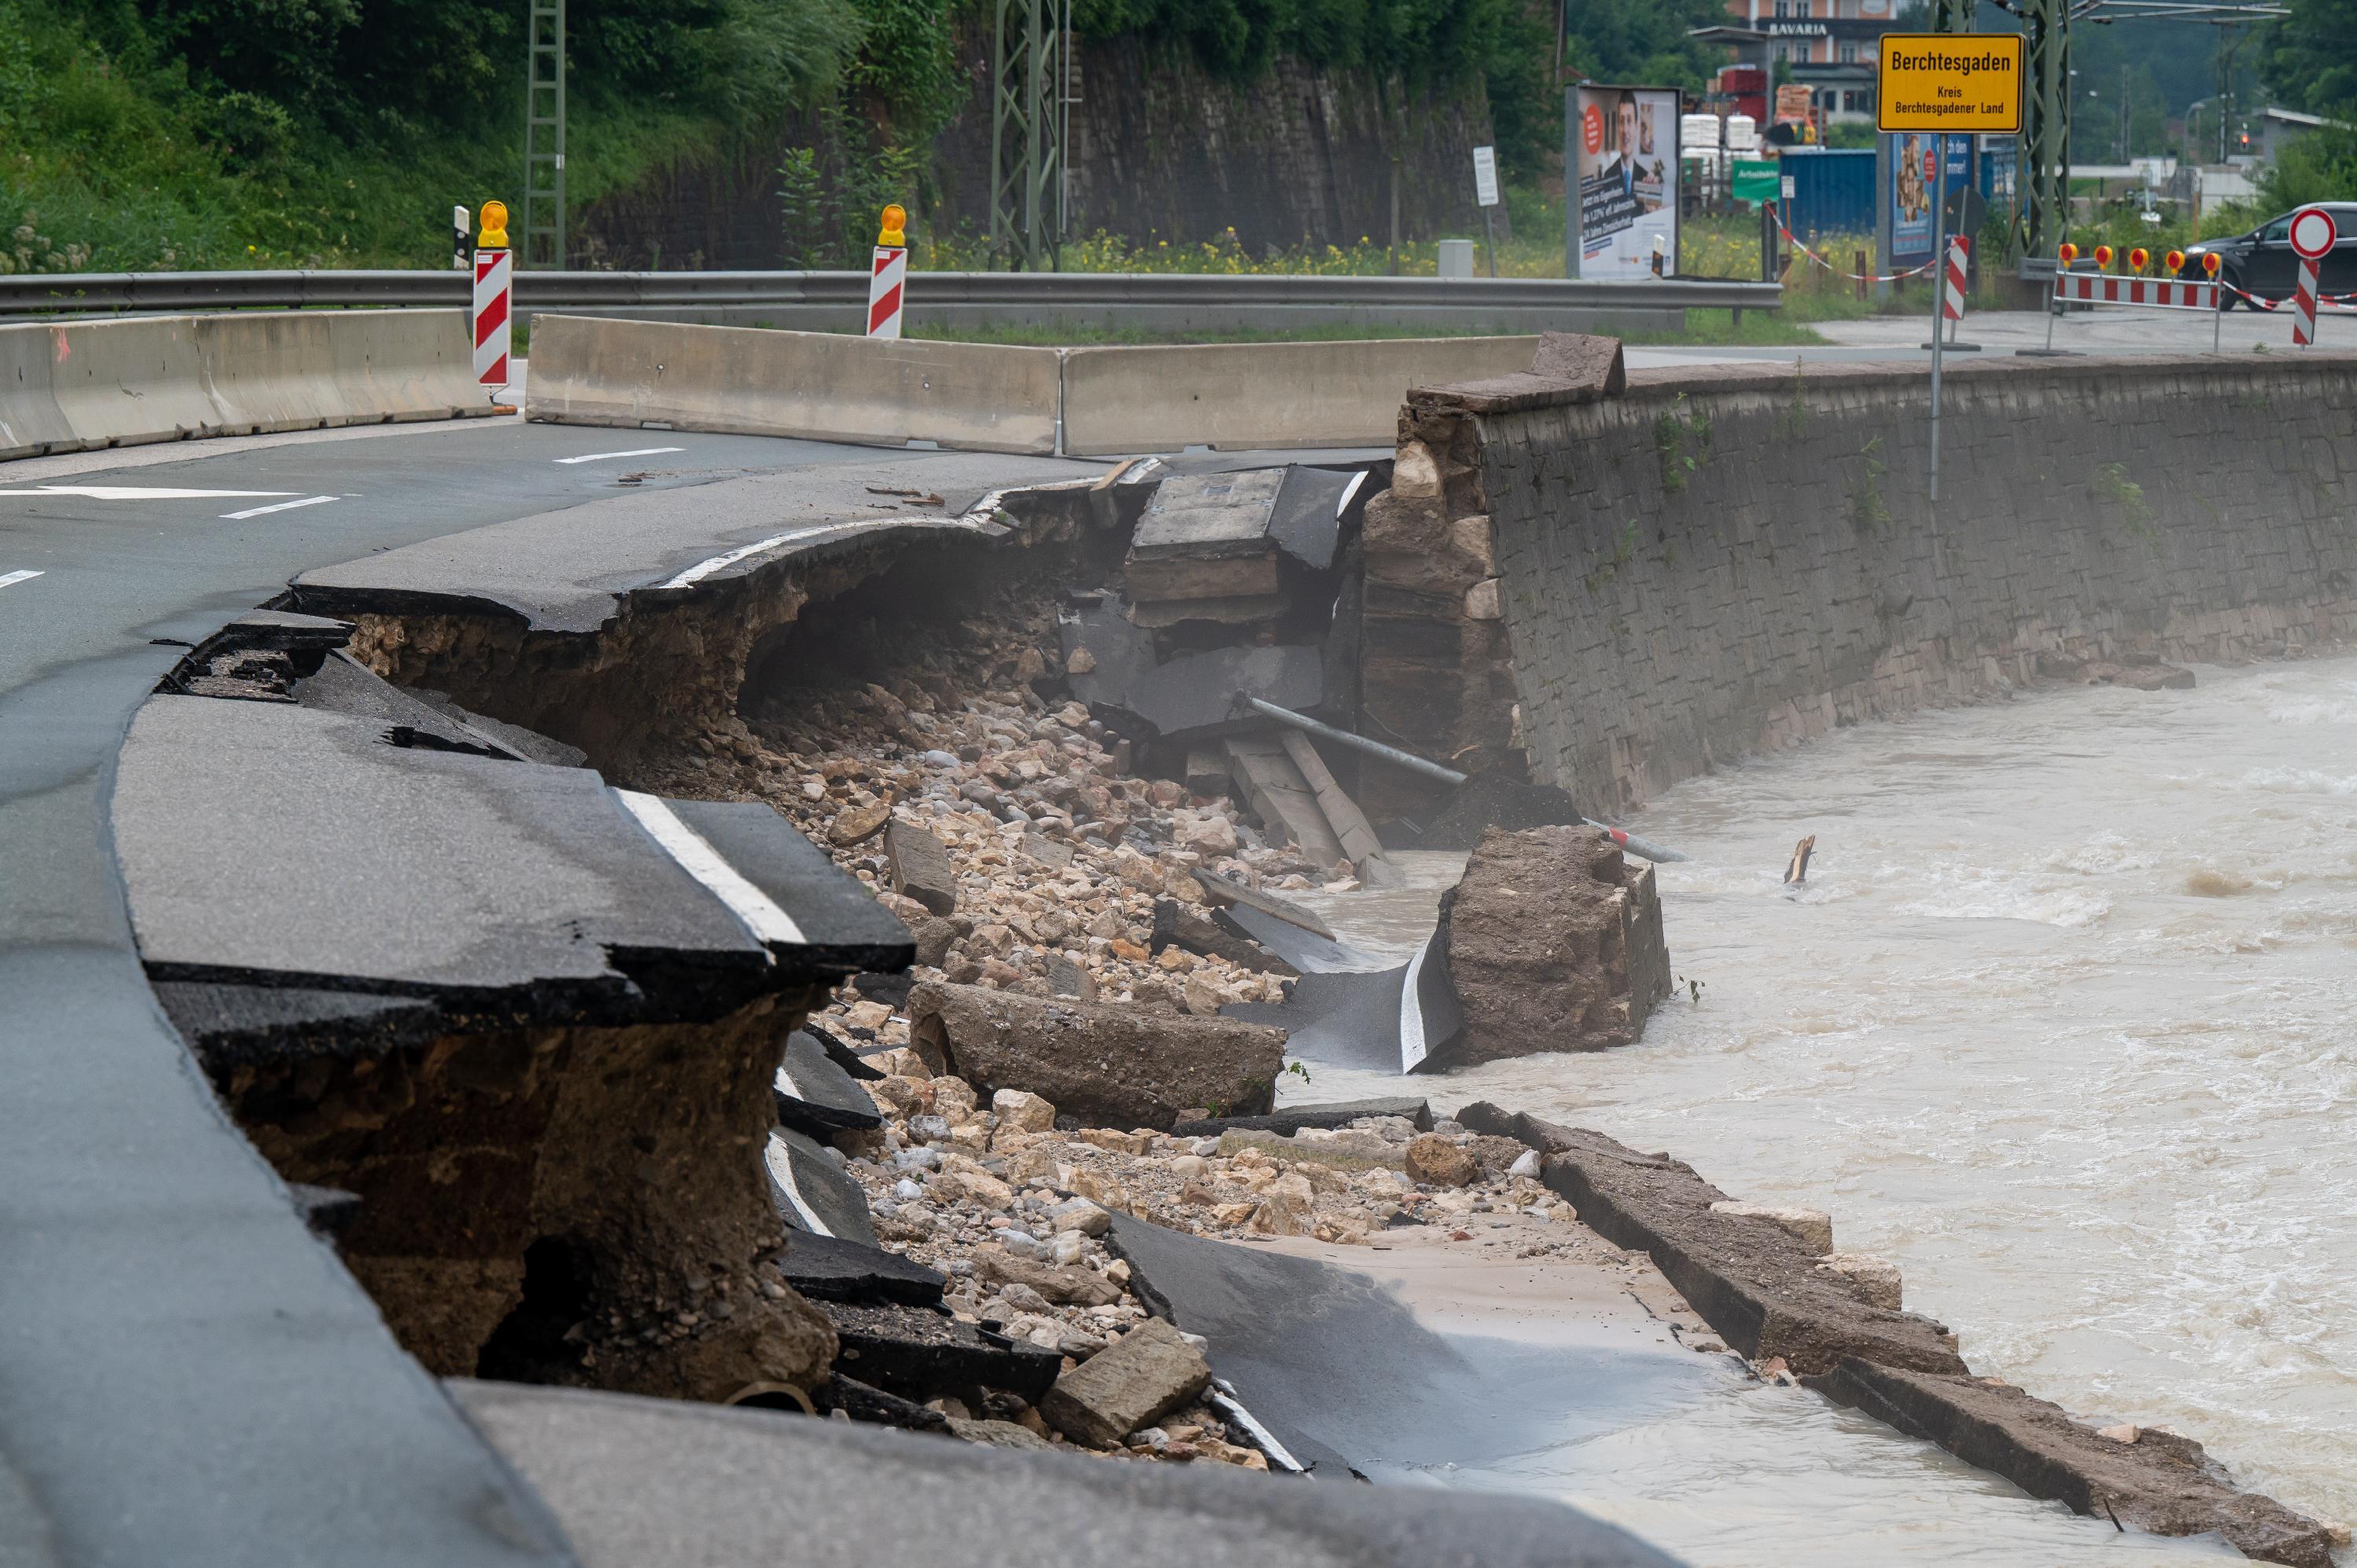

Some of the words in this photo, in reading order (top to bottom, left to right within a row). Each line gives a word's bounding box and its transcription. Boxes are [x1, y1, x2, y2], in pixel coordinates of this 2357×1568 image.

[1769, 24, 1827, 35] BAVARIA
[1892, 51, 2011, 76] Berchtesgaden
[1937, 86, 1962, 98] Kreis
[1895, 101, 1975, 116] Berchtesgadener
[1981, 102, 2004, 114] Land
